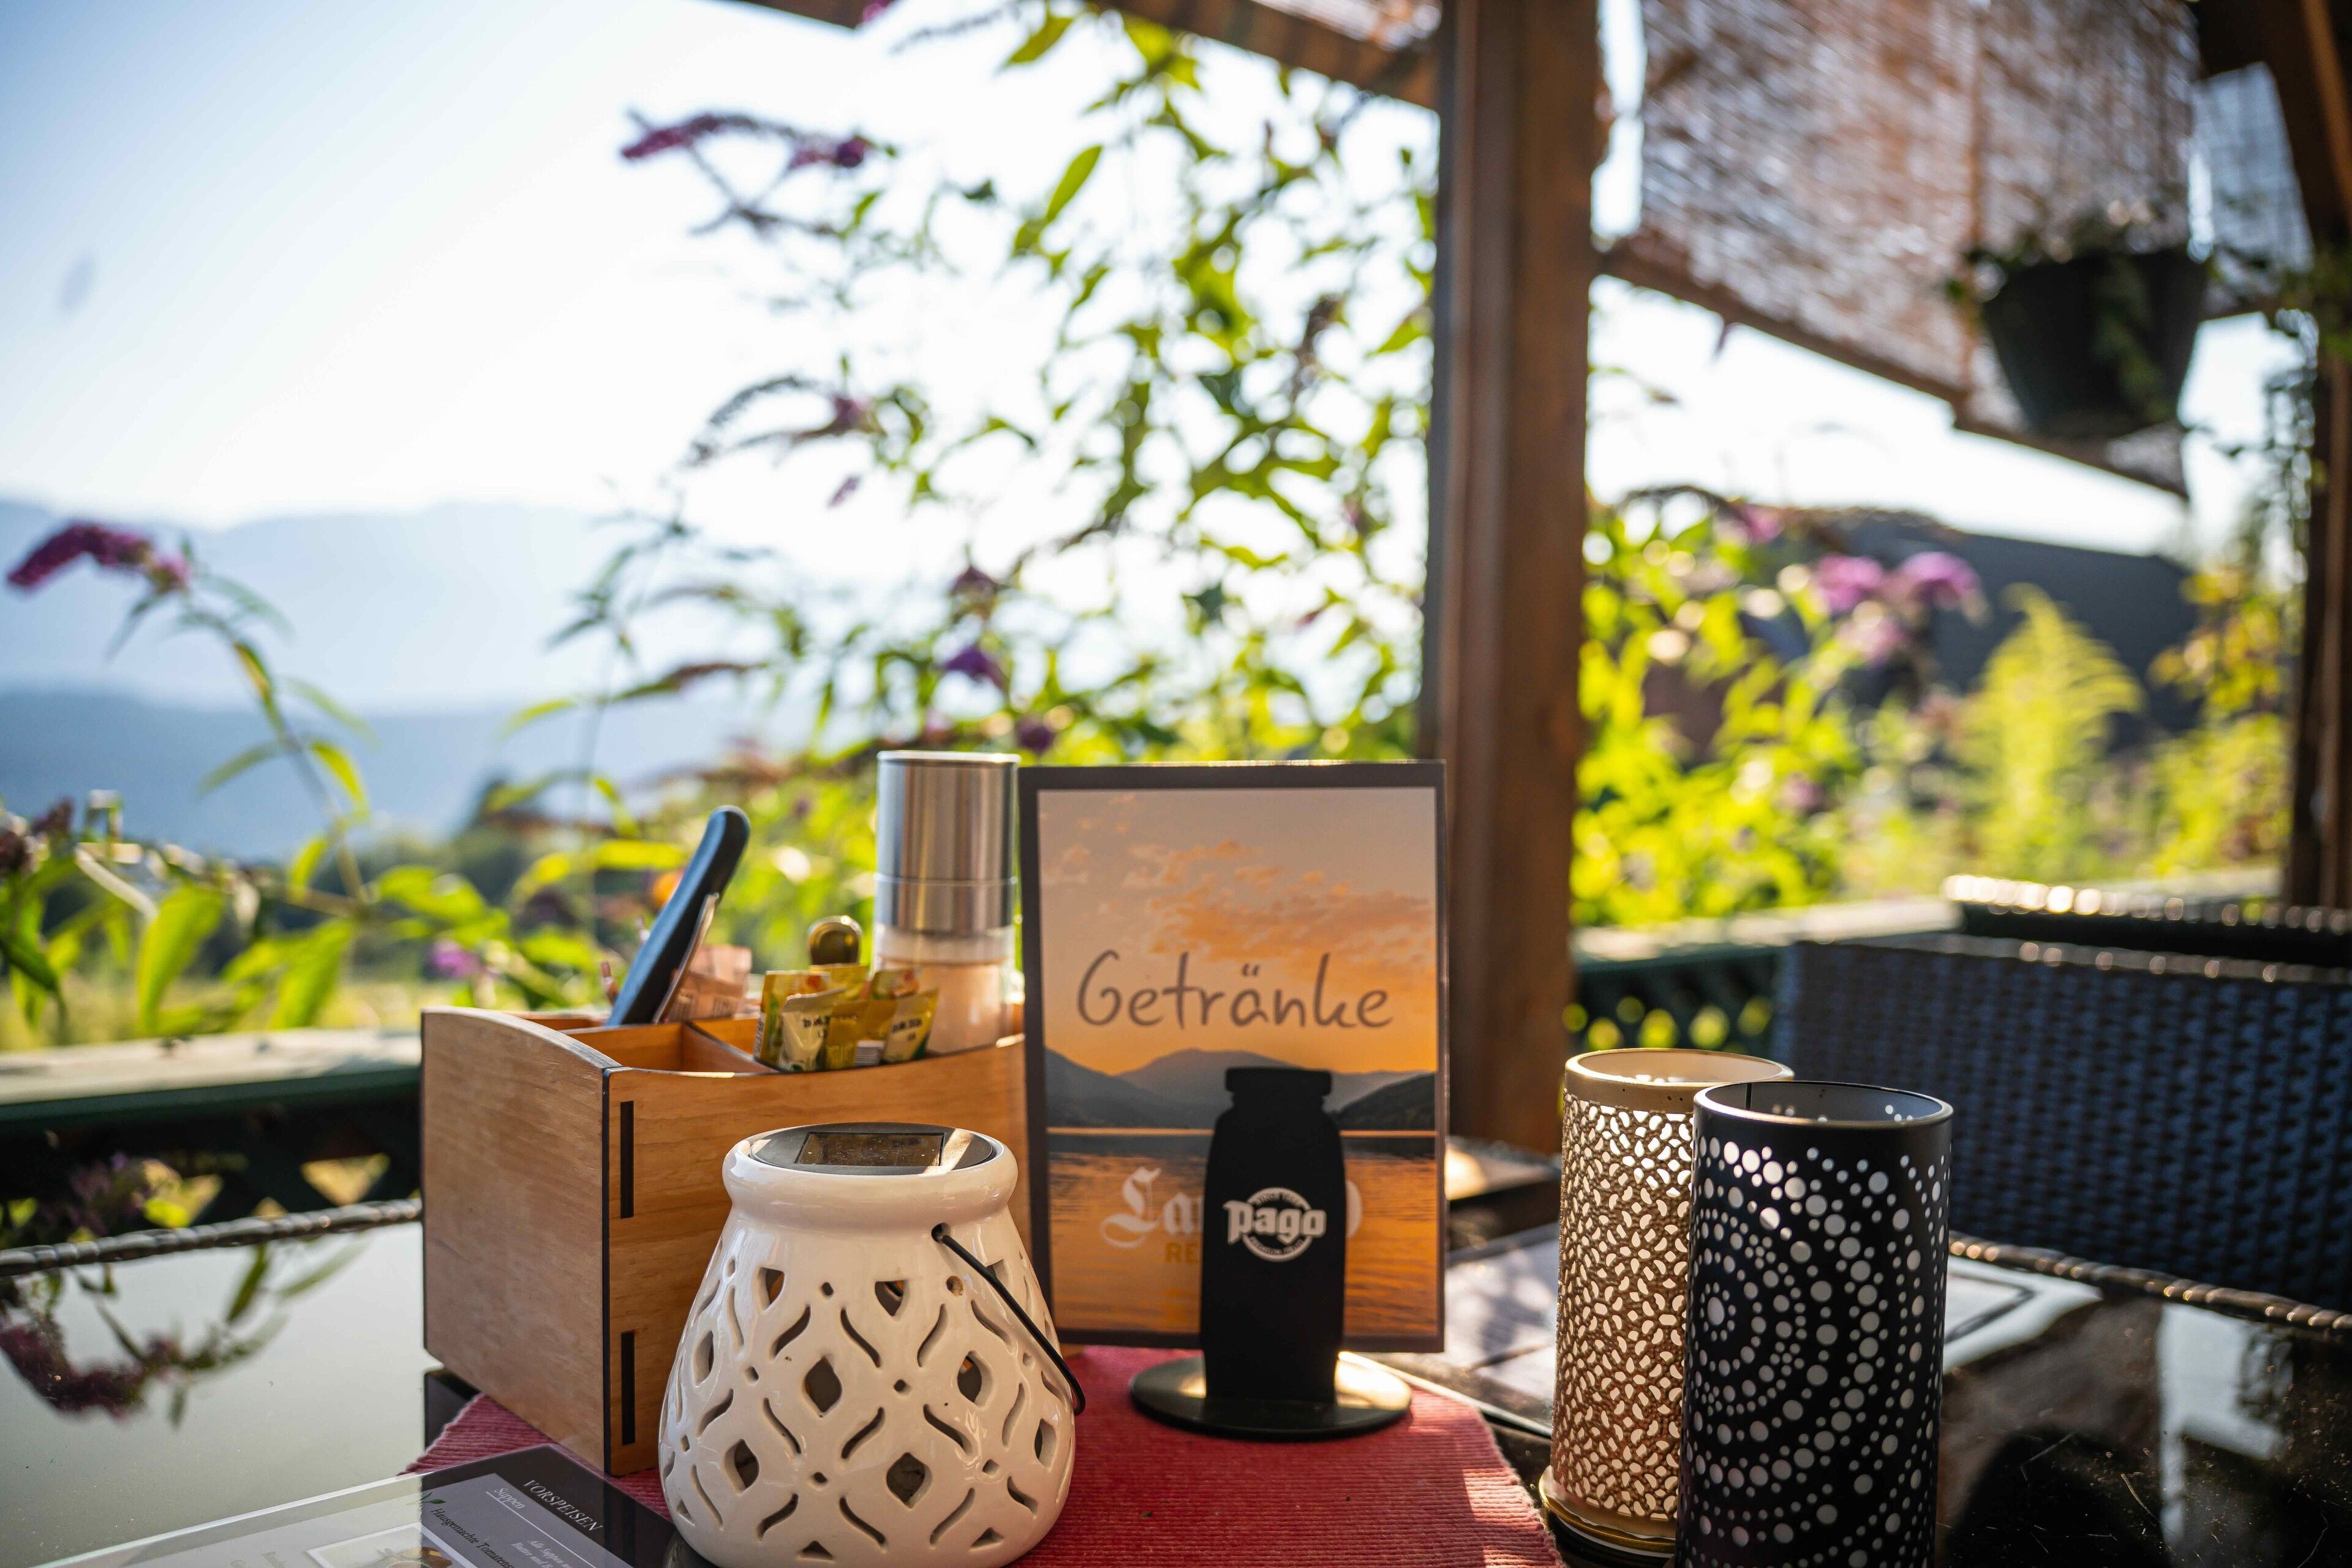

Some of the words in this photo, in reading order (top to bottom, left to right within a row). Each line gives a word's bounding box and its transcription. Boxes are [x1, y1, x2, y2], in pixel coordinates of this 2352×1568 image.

[1076, 949, 1394, 1030] Getränke
[1222, 1199, 1327, 1245] pago
[494, 1487, 526, 1509] Suppen
[523, 1480, 603, 1531] VORSPEISEN
[431, 1508, 480, 1544] Hausgemachte
